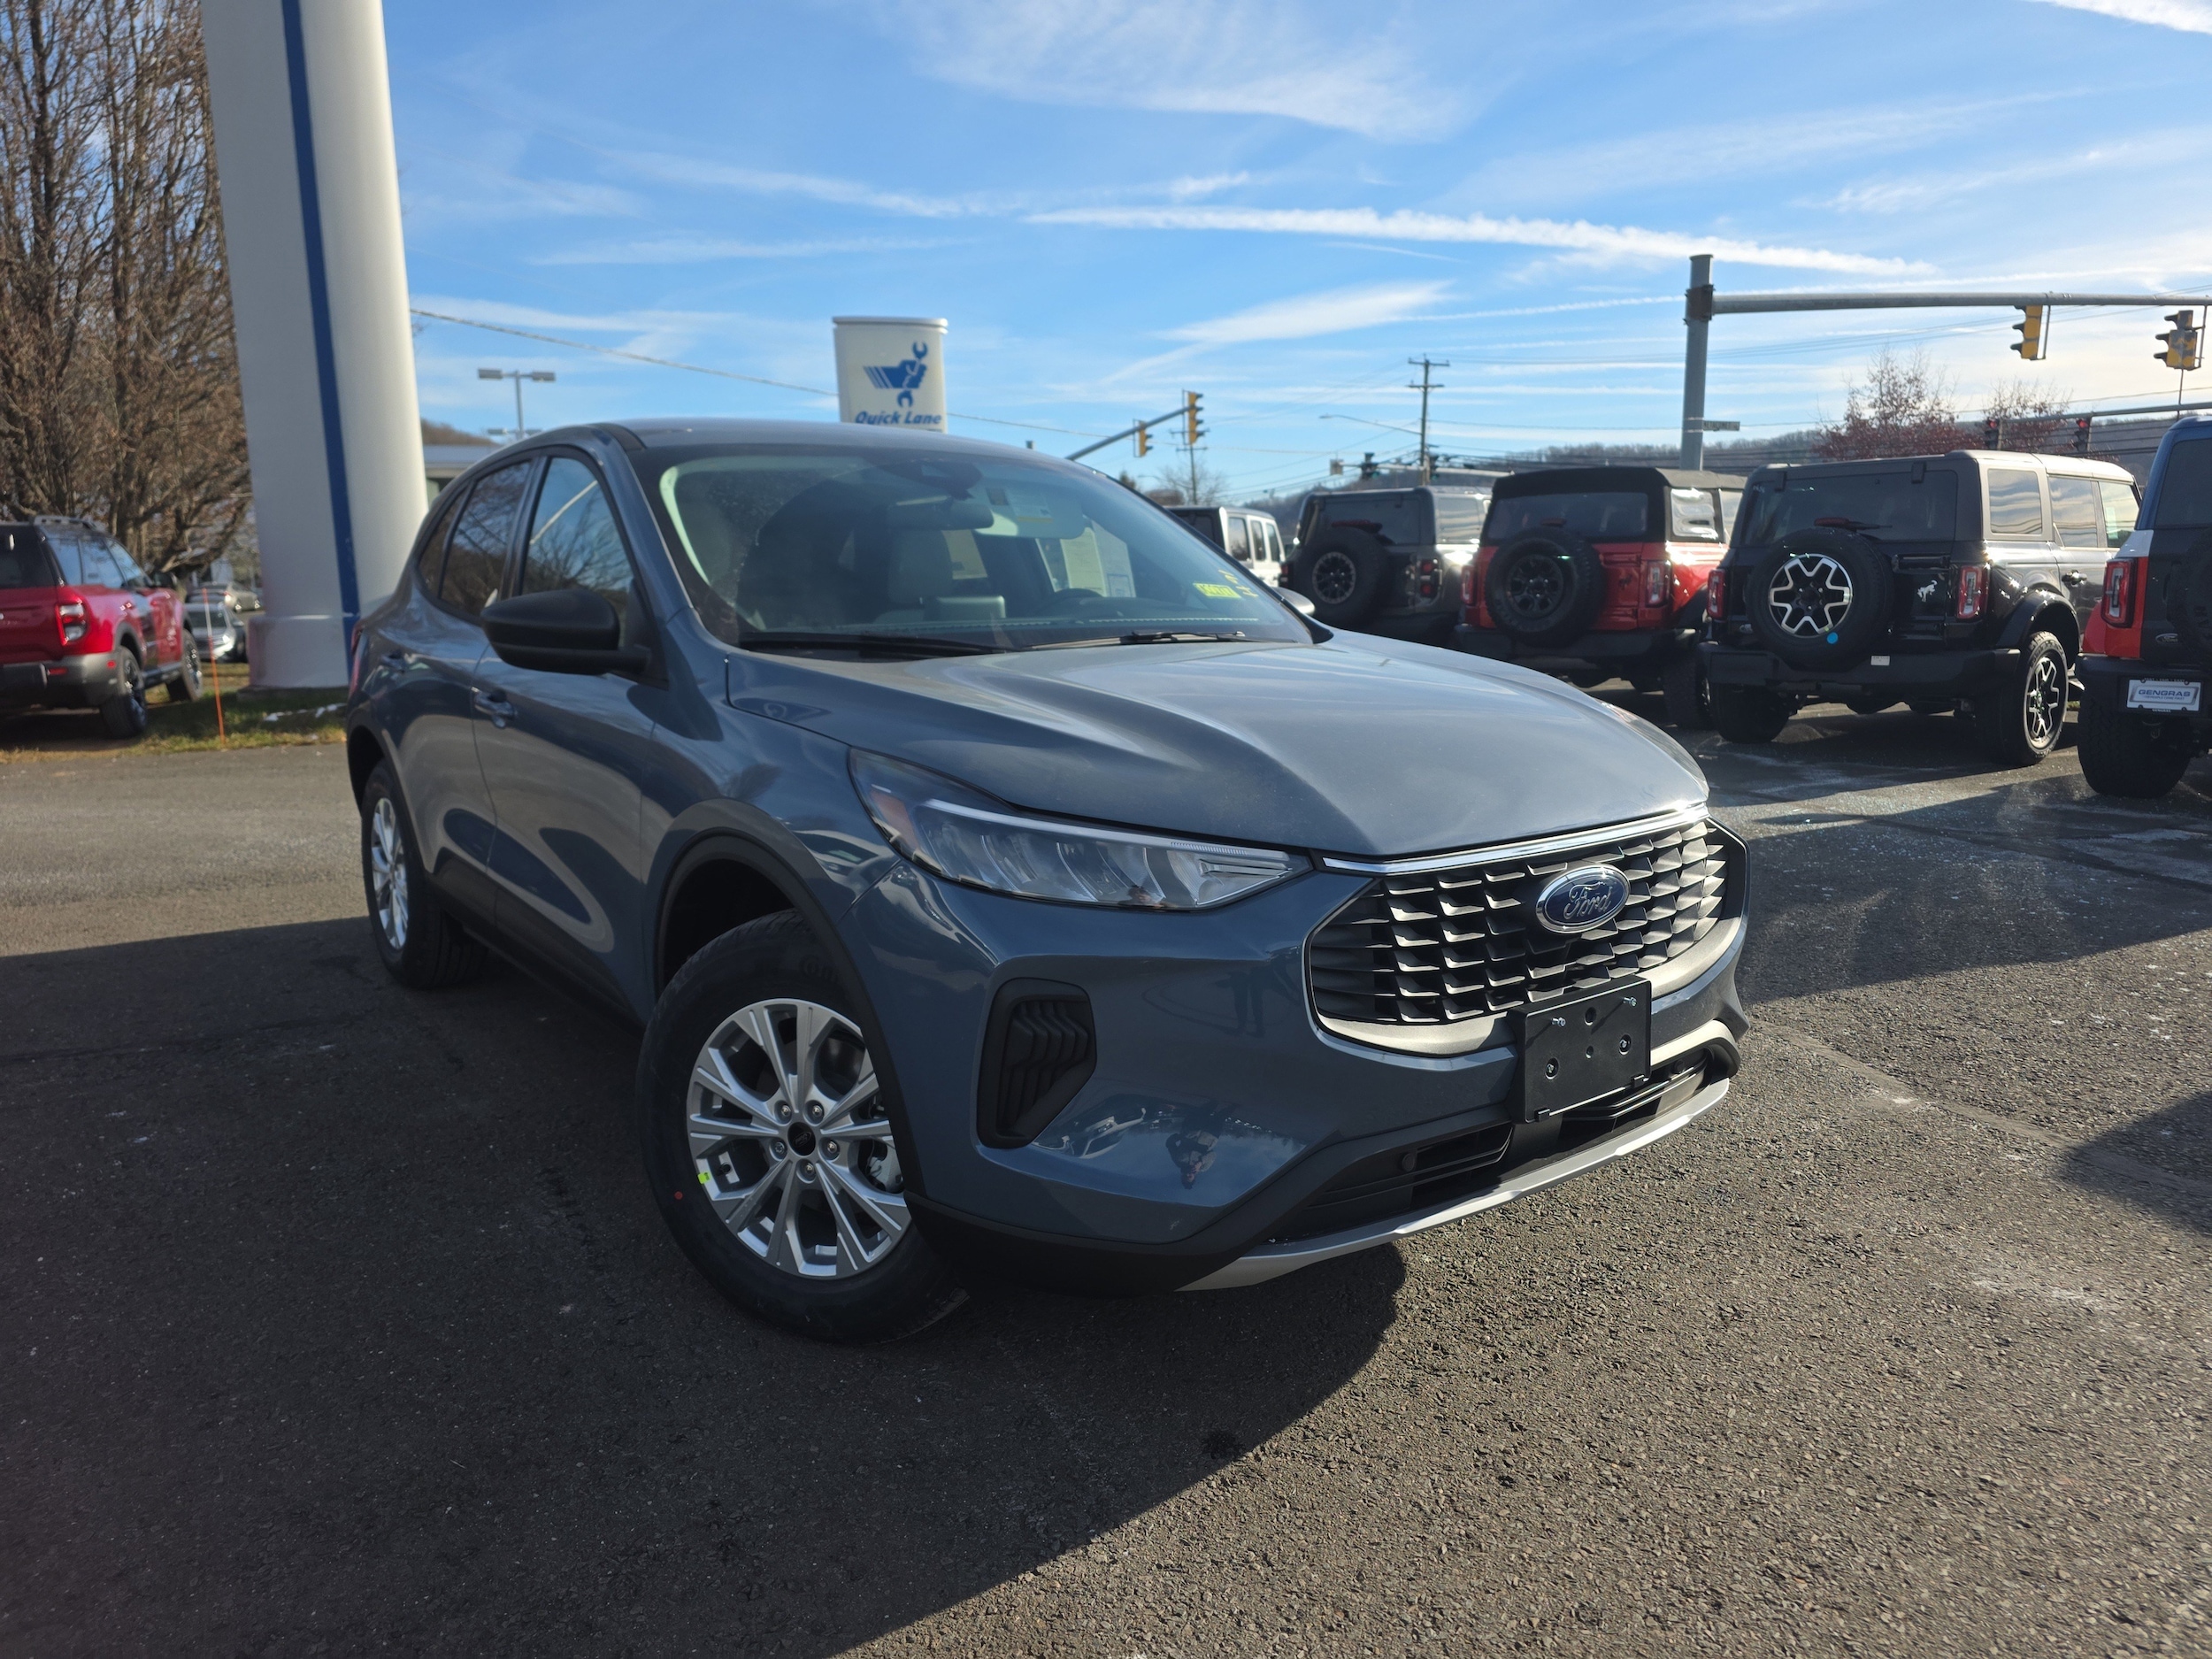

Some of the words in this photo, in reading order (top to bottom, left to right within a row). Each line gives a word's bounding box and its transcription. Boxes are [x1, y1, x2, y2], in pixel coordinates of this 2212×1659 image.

[854, 411, 900, 425] Quick
[904, 411, 942, 425] Lane
[1563, 881, 1613, 919] Ford
